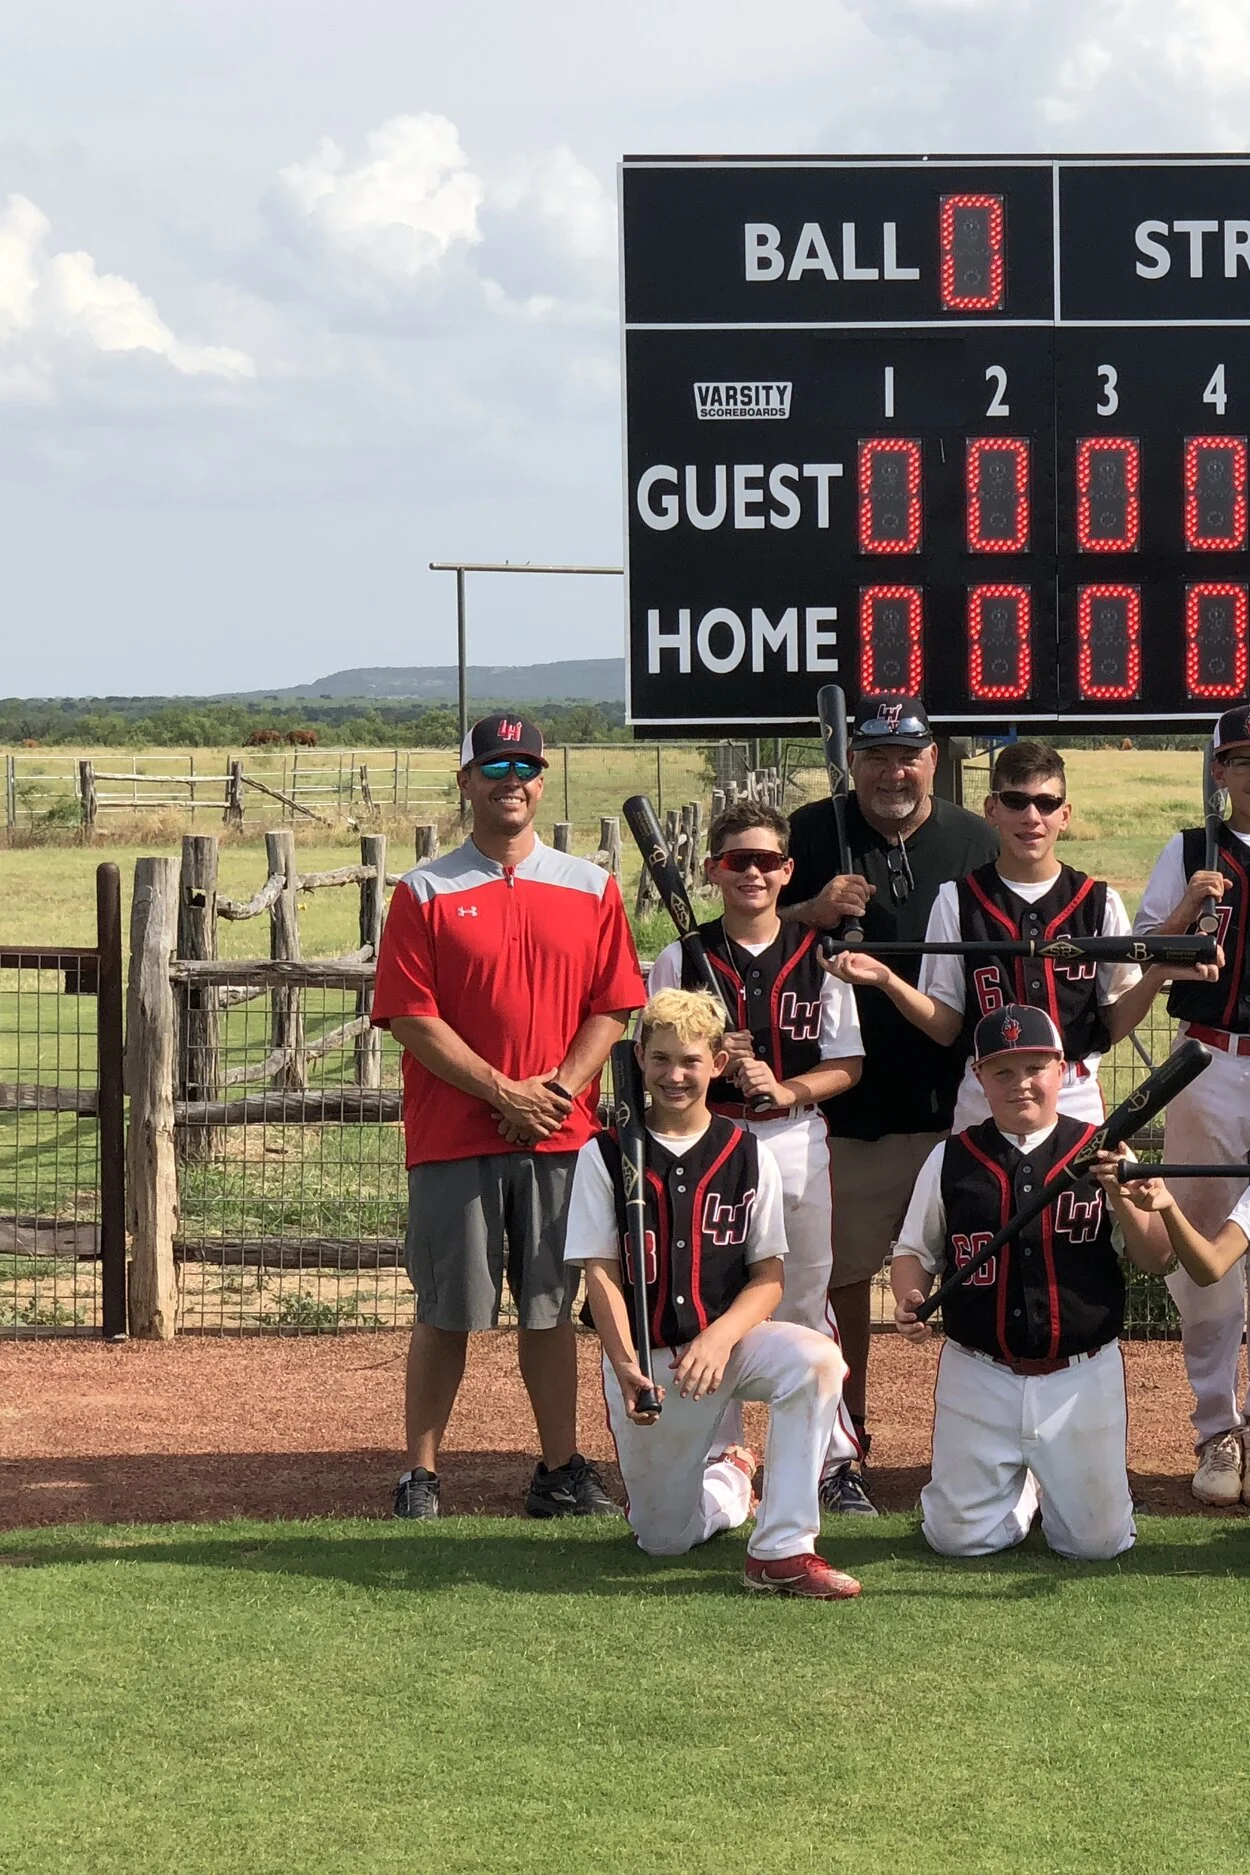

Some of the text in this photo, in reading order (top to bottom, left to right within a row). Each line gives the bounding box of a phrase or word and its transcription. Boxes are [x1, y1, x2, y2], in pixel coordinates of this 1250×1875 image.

[745, 195, 1003, 309] BALL 0
[697, 385, 788, 407] VARSITY
[700, 408, 787, 418] SCOREBOARDS
[884, 367, 894, 417] 1
[985, 366, 1010, 416] 2
[1096, 365, 1119, 415] 3
[1203, 364, 1228, 414] 4
[637, 464, 843, 531] GUEST
[860, 438, 921, 553] 0
[968, 437, 1029, 552] 0
[1076, 437, 1139, 551] 0
[1185, 436, 1247, 549] 0
[648, 607, 838, 674] HOME
[861, 586, 922, 697] 0
[969, 585, 1030, 698] 0
[1078, 585, 1140, 698] 0
[1186, 584, 1248, 697] 0
